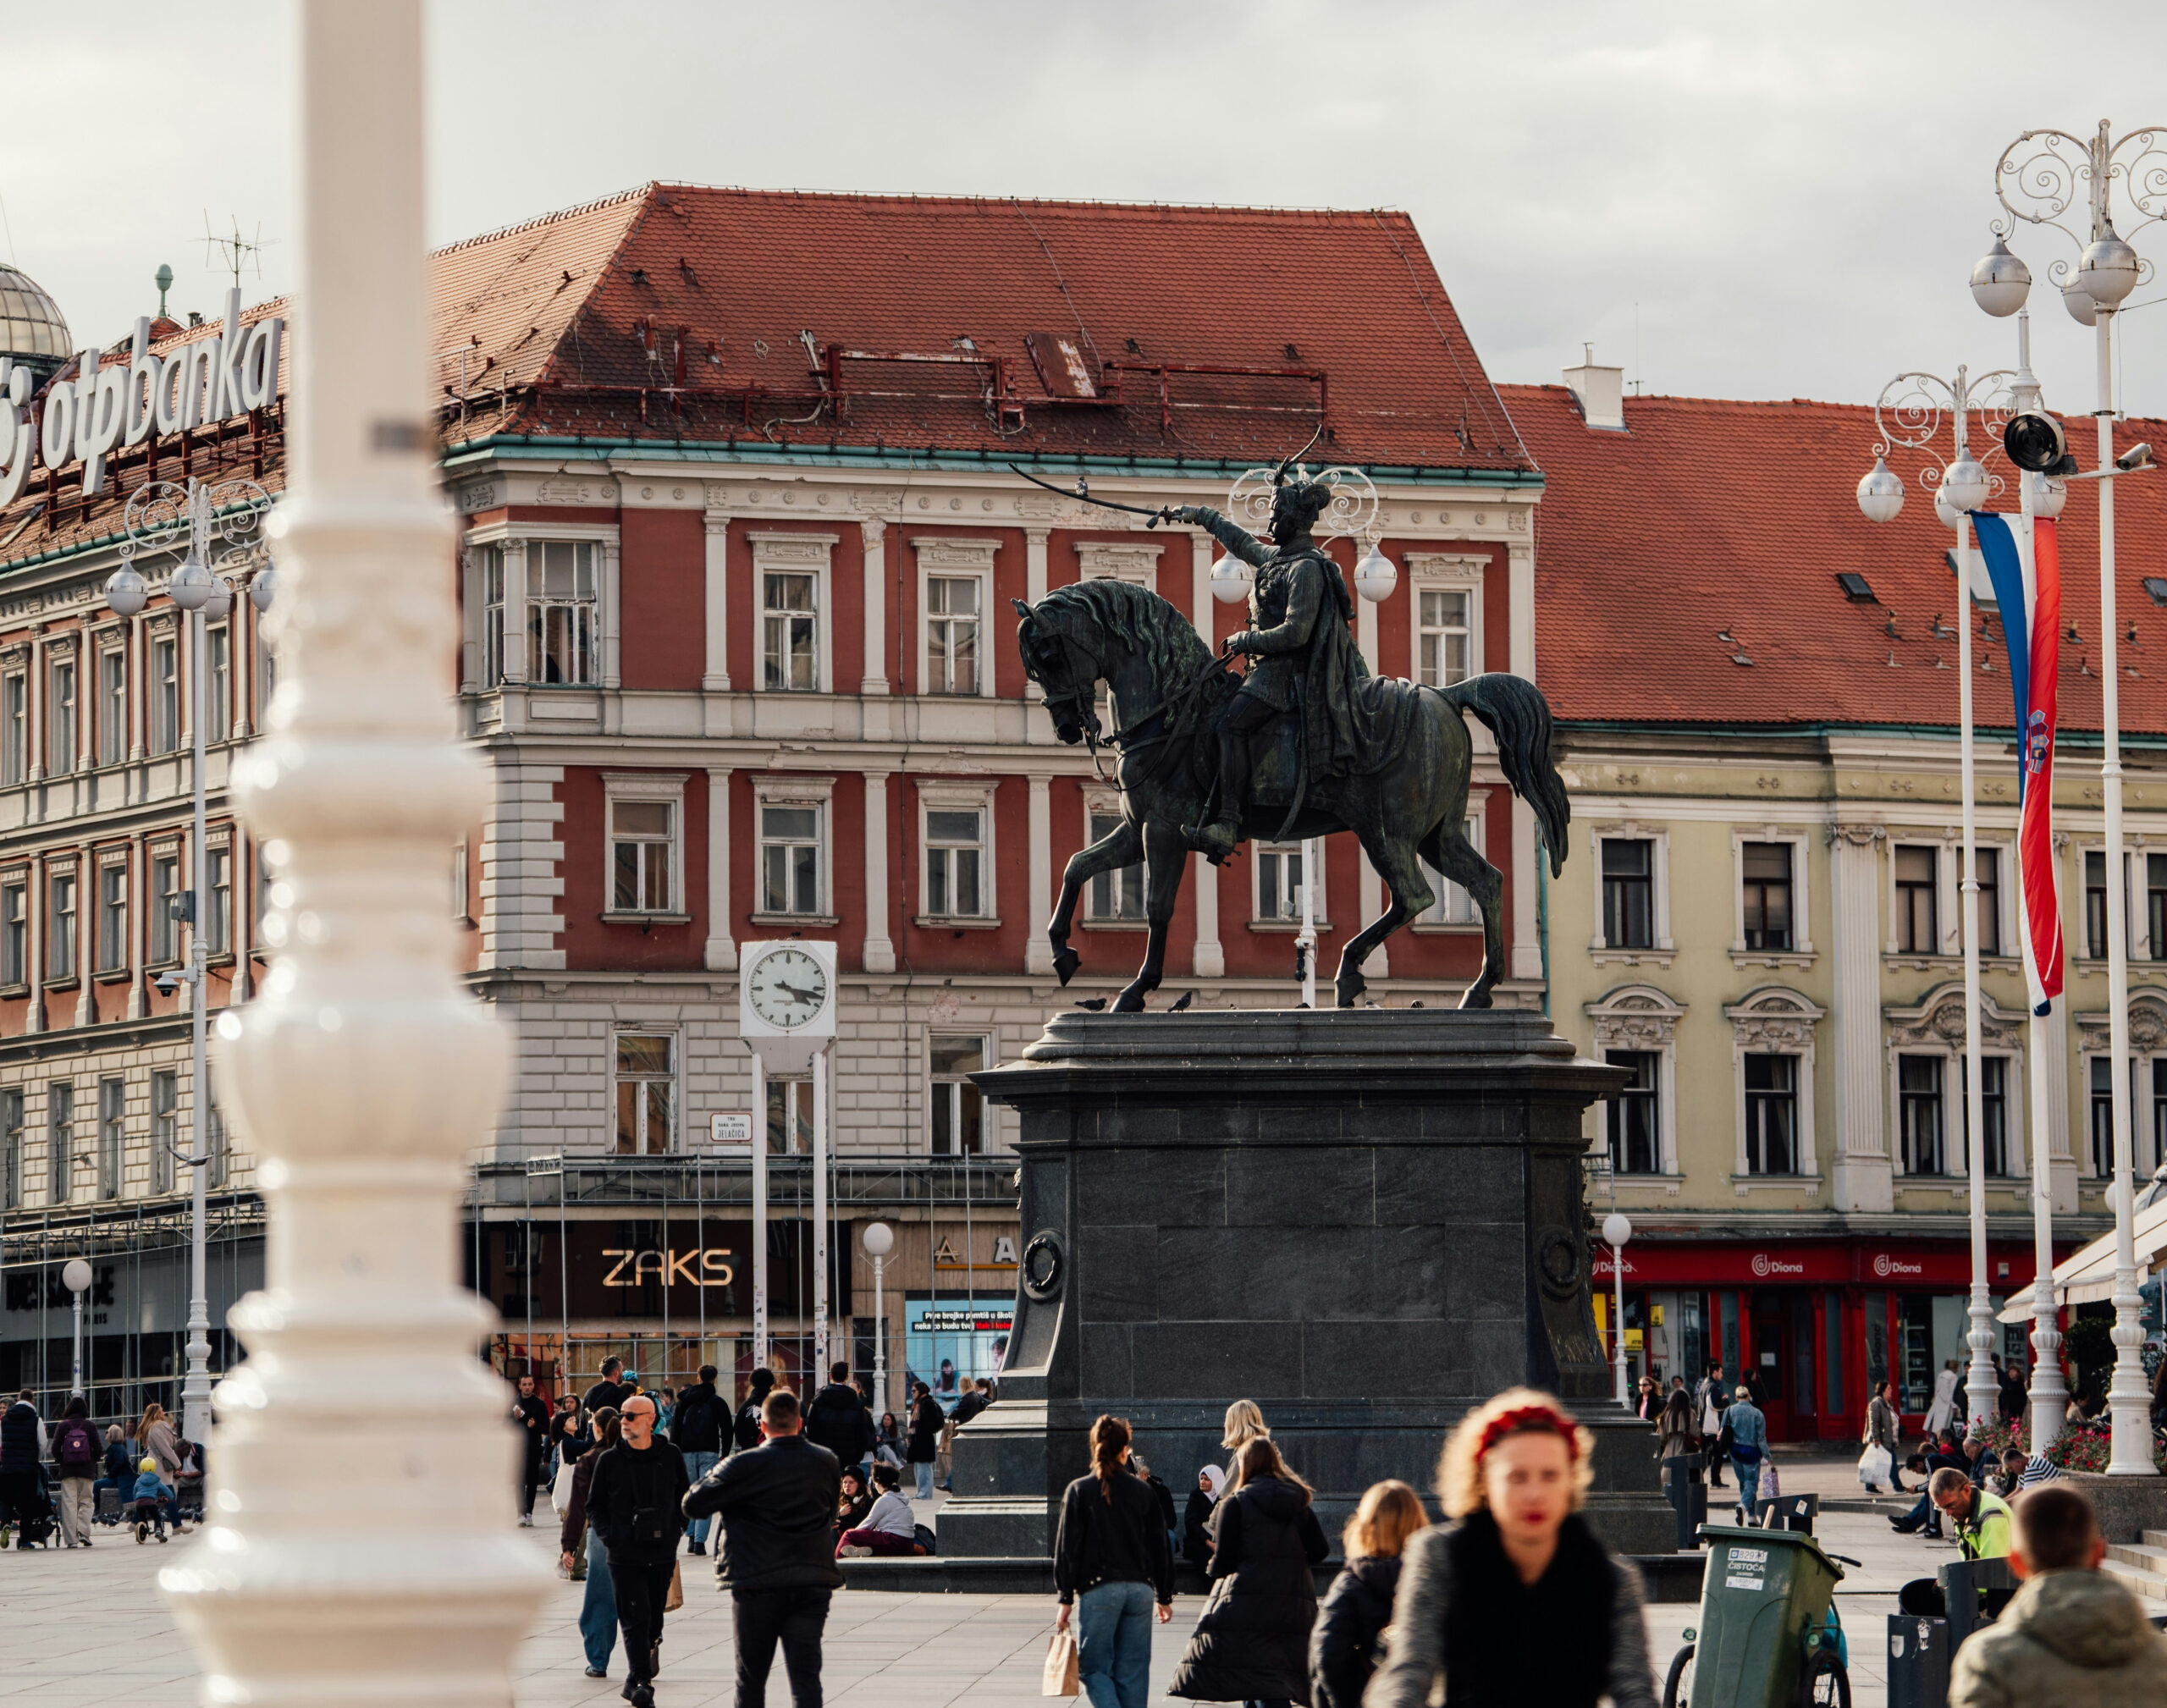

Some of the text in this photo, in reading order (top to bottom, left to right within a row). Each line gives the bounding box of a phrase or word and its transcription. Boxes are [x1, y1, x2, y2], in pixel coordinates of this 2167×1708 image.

[42, 288, 283, 496] otpbanka
[602, 1249, 733, 1287] ZAKS
[1771, 1261, 1803, 1273] Diona
[1892, 1261, 1922, 1273] Diona
[942, 1312, 964, 1320] brojke
